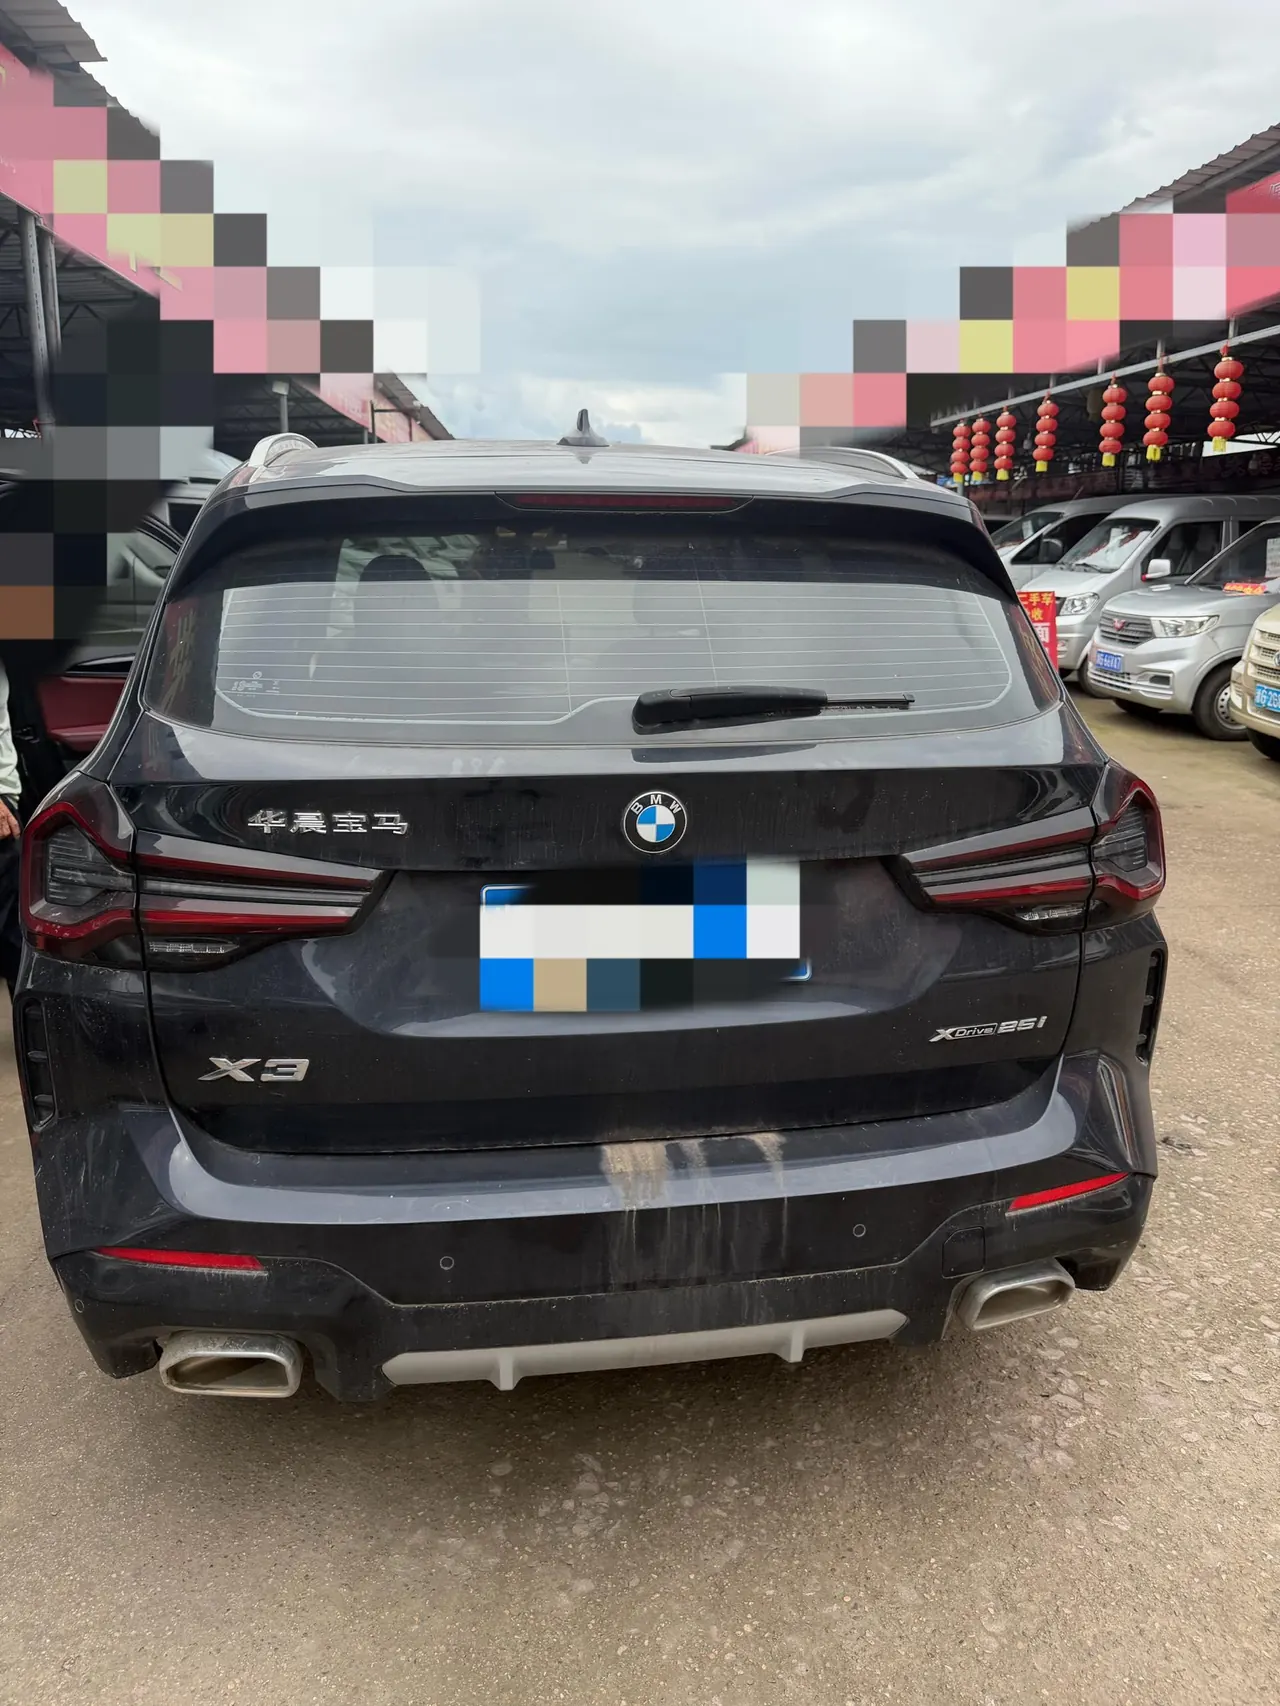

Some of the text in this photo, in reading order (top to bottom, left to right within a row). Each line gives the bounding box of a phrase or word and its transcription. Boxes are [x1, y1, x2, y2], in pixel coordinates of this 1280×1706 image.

[630, 794, 682, 815] BMW
[248, 810, 408, 834] 华晨宝马
[198, 1057, 309, 1081] X3
